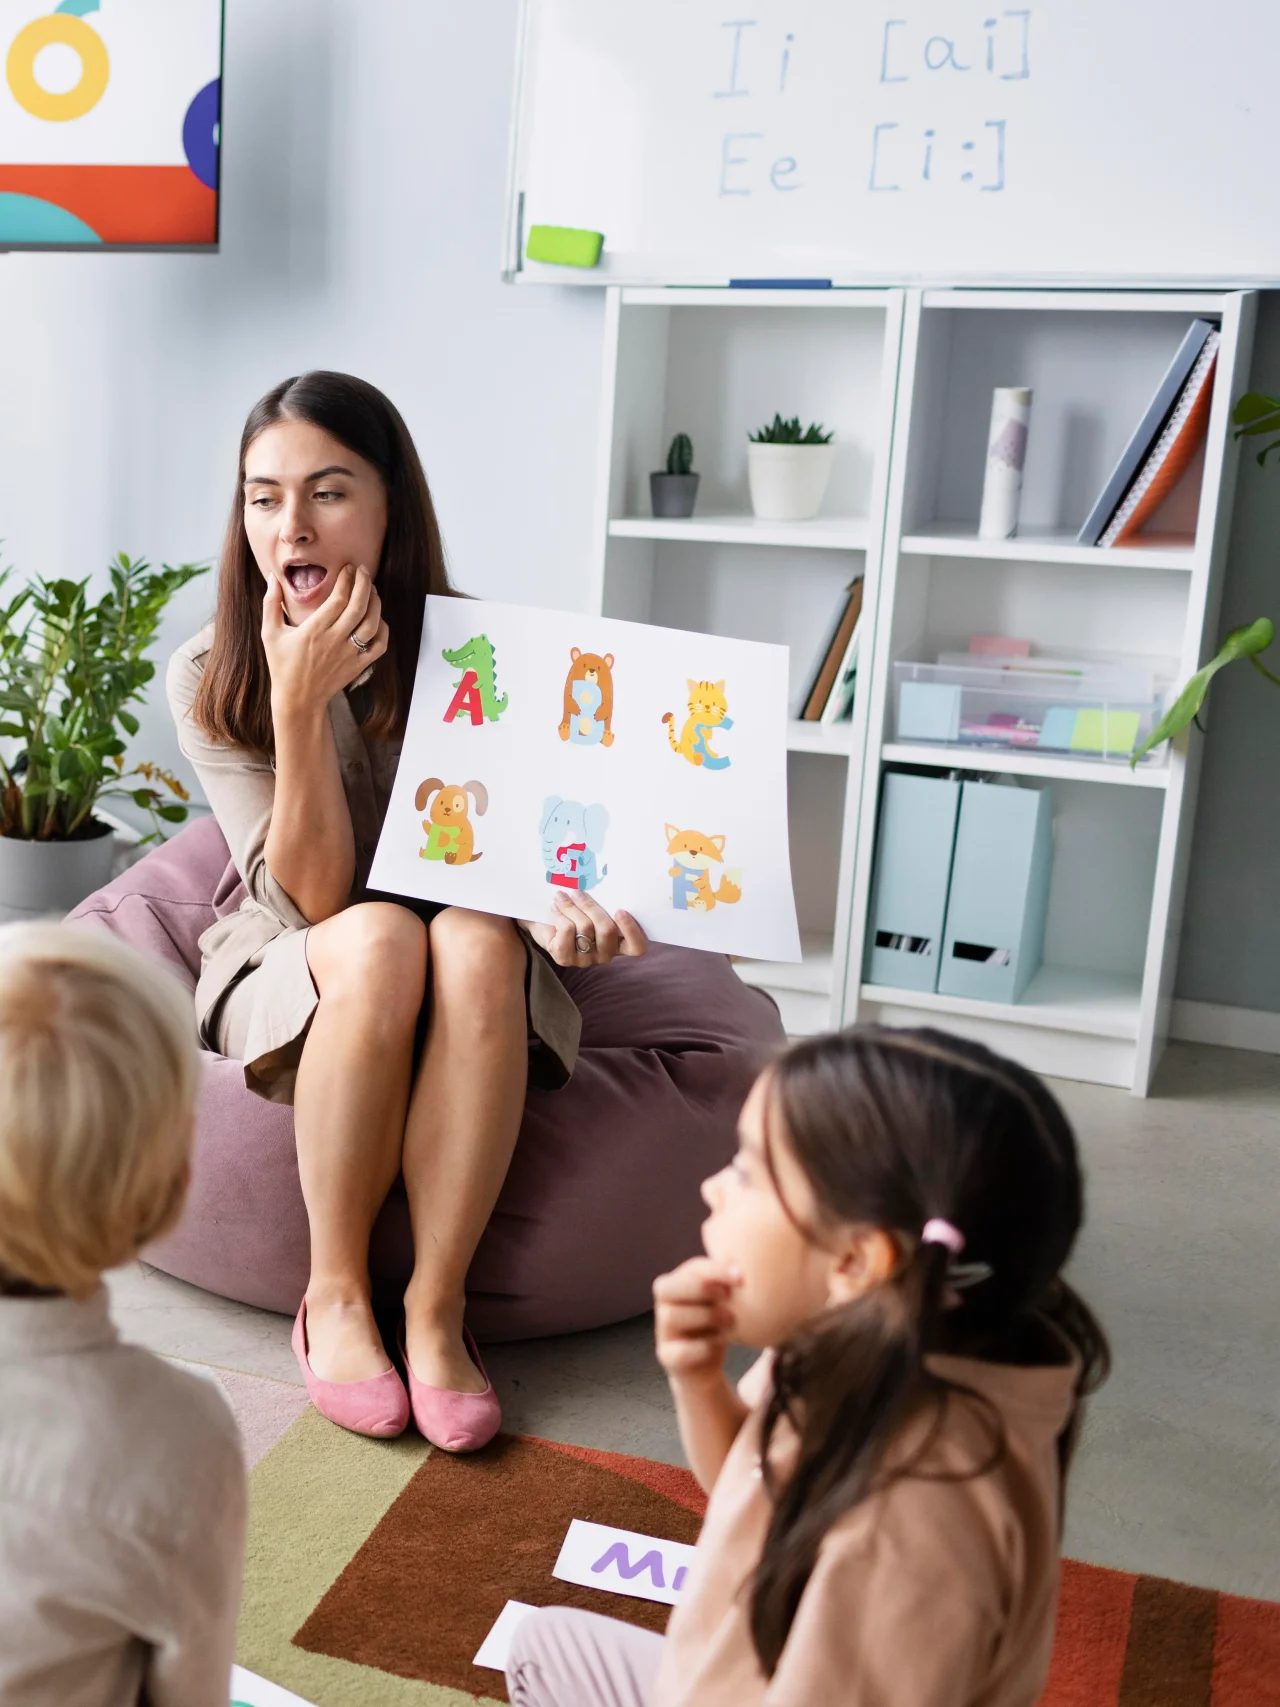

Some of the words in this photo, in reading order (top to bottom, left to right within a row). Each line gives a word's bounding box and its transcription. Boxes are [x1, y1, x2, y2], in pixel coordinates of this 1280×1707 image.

[879, 10, 1031, 83] [ai]
[719, 132, 806, 199] Ee
[868, 119, 1006, 192] [i:]
[443, 671, 484, 726] A
[569, 680, 605, 746] B
[692, 716, 734, 770] C
[423, 822, 461, 861] D
[672, 857, 704, 911] F
[591, 1542, 688, 1591] M
